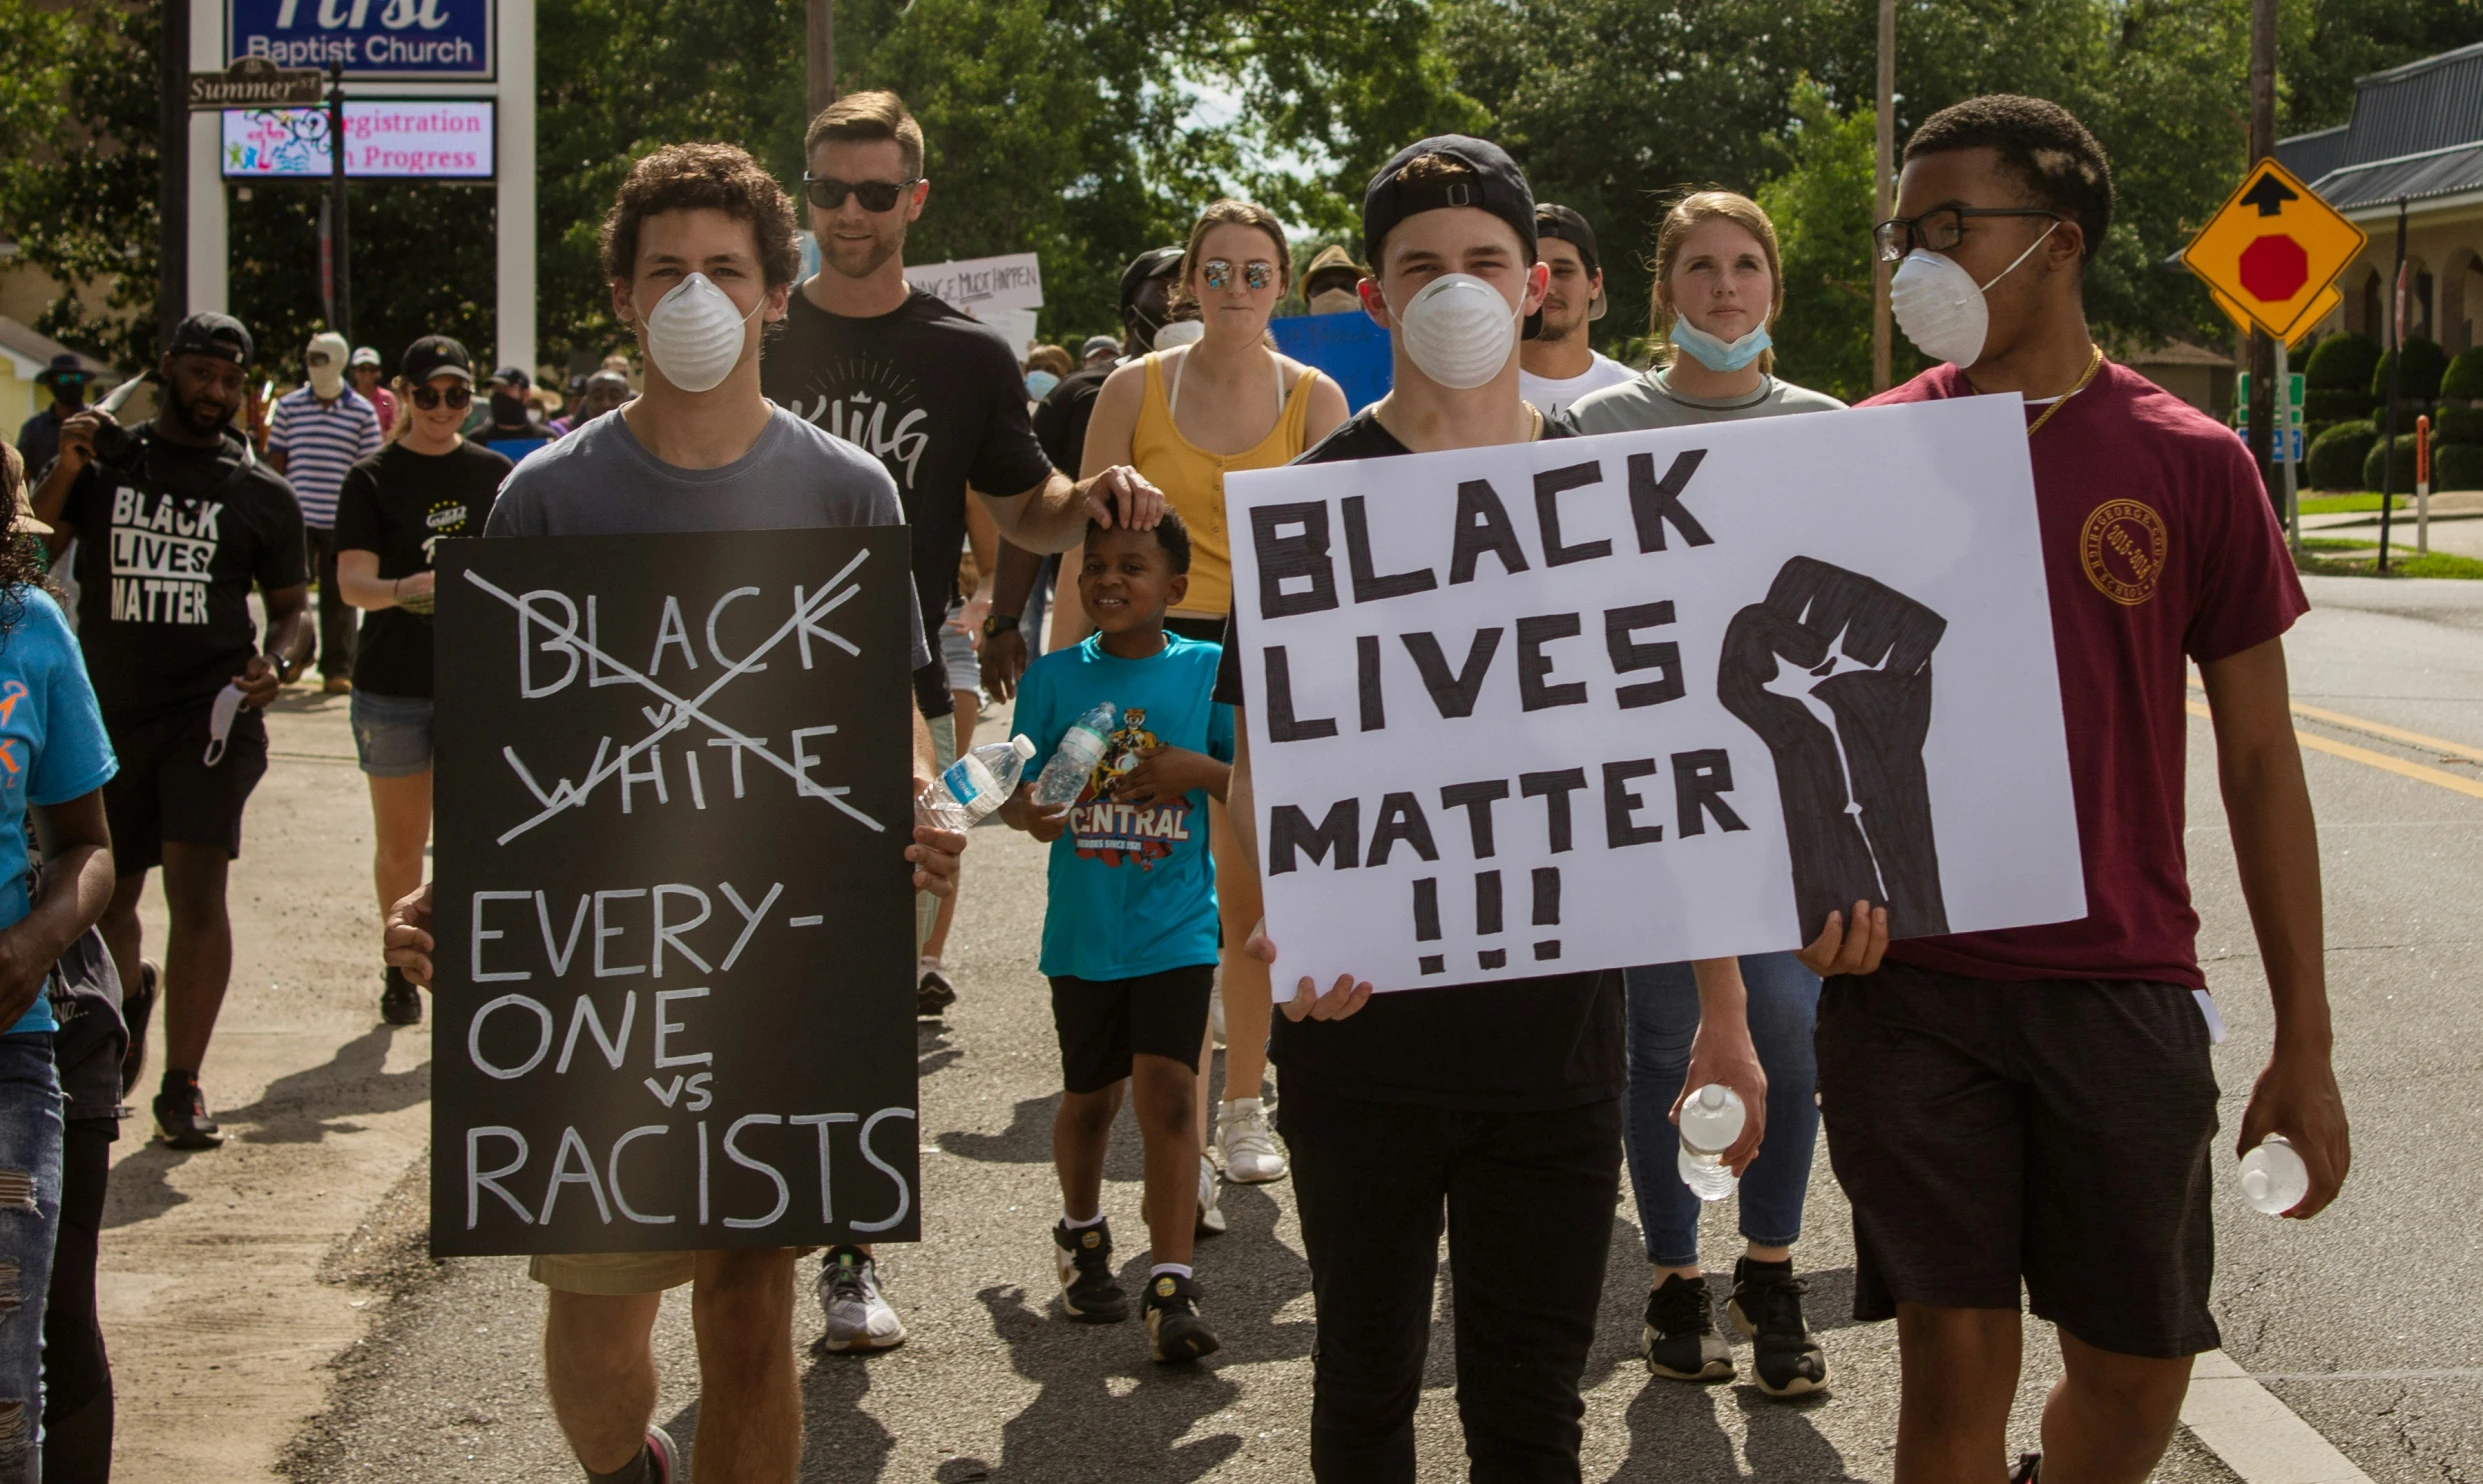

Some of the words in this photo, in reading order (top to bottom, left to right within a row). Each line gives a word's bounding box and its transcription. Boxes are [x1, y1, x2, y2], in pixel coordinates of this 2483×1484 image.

[190, 78, 297, 101] Summer
[247, 35, 357, 67] Baptist
[365, 35, 474, 63] Church
[342, 108, 481, 140] egistration
[364, 147, 477, 172] Progress
[111, 486, 224, 541] BLACK
[113, 532, 210, 574] LIVES
[1249, 448, 1716, 621] BLACK
[2097, 506, 2151, 525] GEORGE
[111, 577, 209, 625] MATTER
[518, 584, 862, 699] BLACK
[1264, 600, 1687, 744] LIVES
[503, 724, 851, 815] WHITE
[1268, 748, 1750, 877] MATTER
[472, 881, 824, 982] EVERY-
[1412, 866, 1563, 977] !!!
[468, 988, 714, 1080] ONE
[466, 1107, 917, 1232] RACISTS
